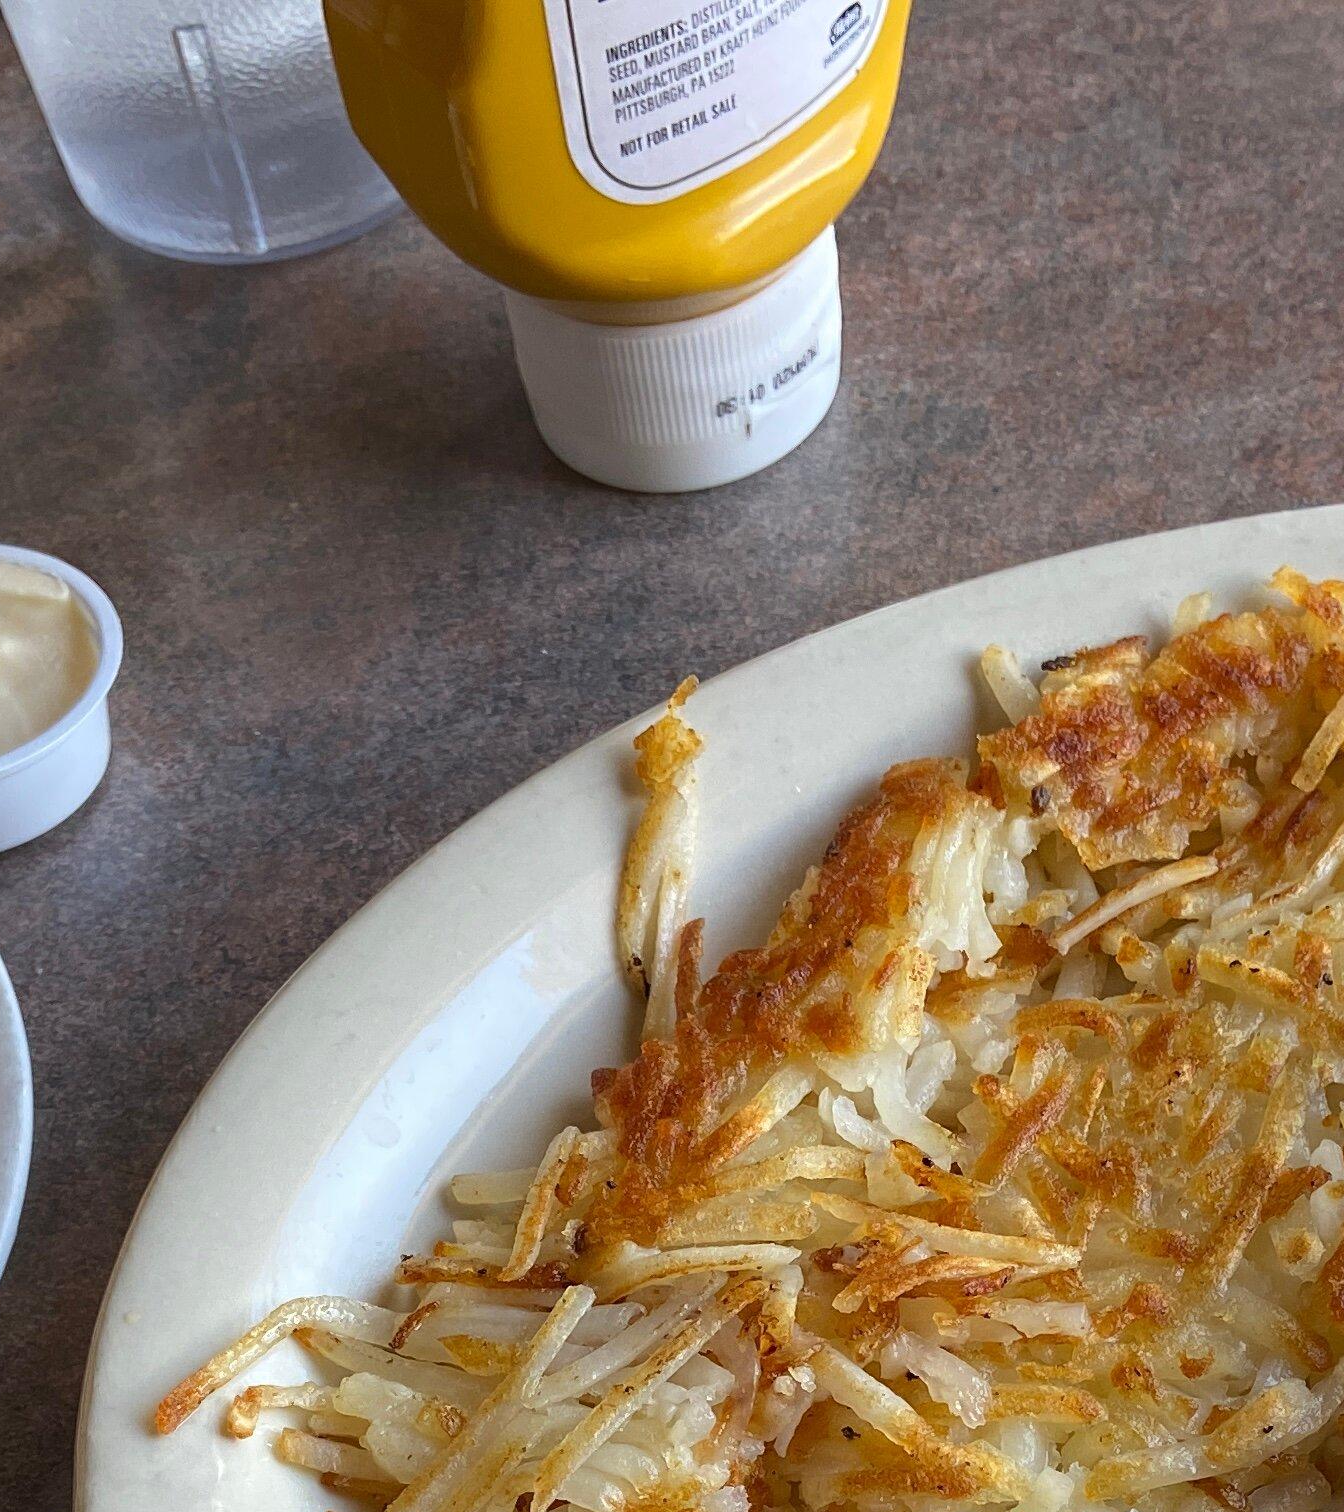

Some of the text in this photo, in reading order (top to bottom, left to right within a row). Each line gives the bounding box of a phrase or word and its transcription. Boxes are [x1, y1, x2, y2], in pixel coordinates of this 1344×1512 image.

[605, 19, 688, 64] INGREDIENTS:
[608, 61, 642, 83] SEED,
[644, 33, 699, 69] MUSTARD
[701, 16, 734, 45] BRAN,
[612, 56, 701, 106] MANUFACTURED
[703, 48, 717, 67] BY
[719, 28, 750, 59] KRAFT
[752, 9, 778, 39] HEINZ
[614, 59, 735, 124] PITTSBURGH, PA 15222
[620, 94, 738, 158] NOT FOR RETAIL SALE
